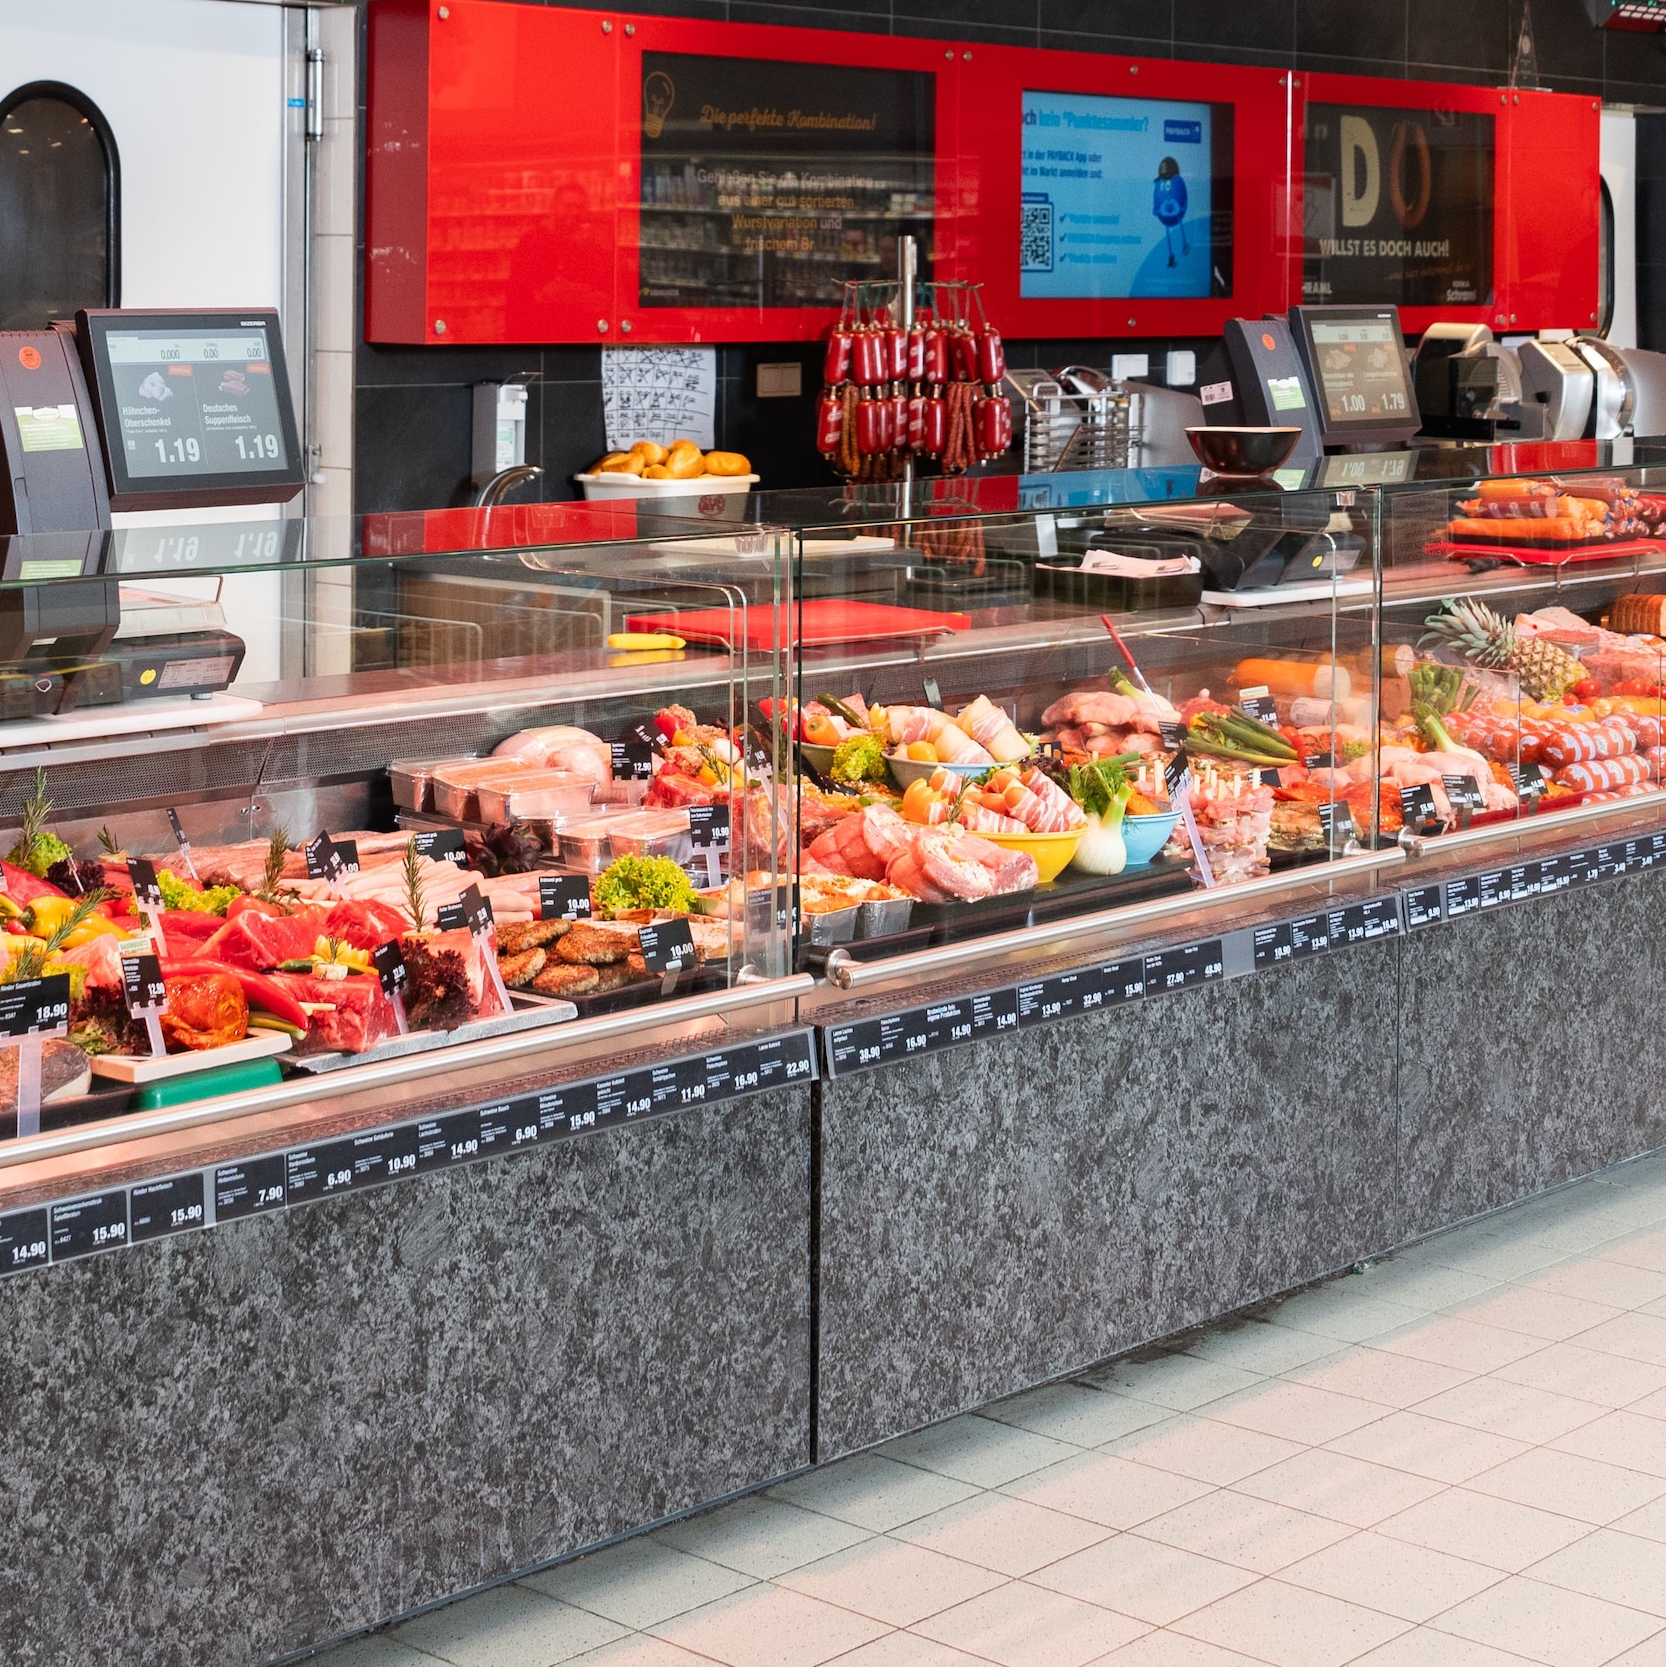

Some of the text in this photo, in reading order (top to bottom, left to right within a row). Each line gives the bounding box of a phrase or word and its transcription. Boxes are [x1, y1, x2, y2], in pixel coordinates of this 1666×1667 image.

[700, 104, 876, 131] Die perfekte Kombination!
[718, 195, 741, 207] aus
[733, 215, 842, 230] Wurstvariation und
[1320, 239, 1449, 257] WILLST ES DOCH AUCH!
[161, 347, 262, 360] 0,000 0,00 0,00
[202, 403, 237, 413] Deutsches
[1341, 394, 1366, 412] 1.00
[1381, 393, 1405, 410] 1.79
[123, 406, 160, 416] Hähnchen-
[124, 417, 171, 428] Oberschenkel
[204, 414, 251, 426] Suppenfleisch
[155, 437, 200, 463] 1.19
[235, 434, 279, 459] 1.19
[567, 898, 589, 909] 10.00
[786, 1060, 810, 1074] 22.90
[93, 1222, 125, 1241] 15.90
